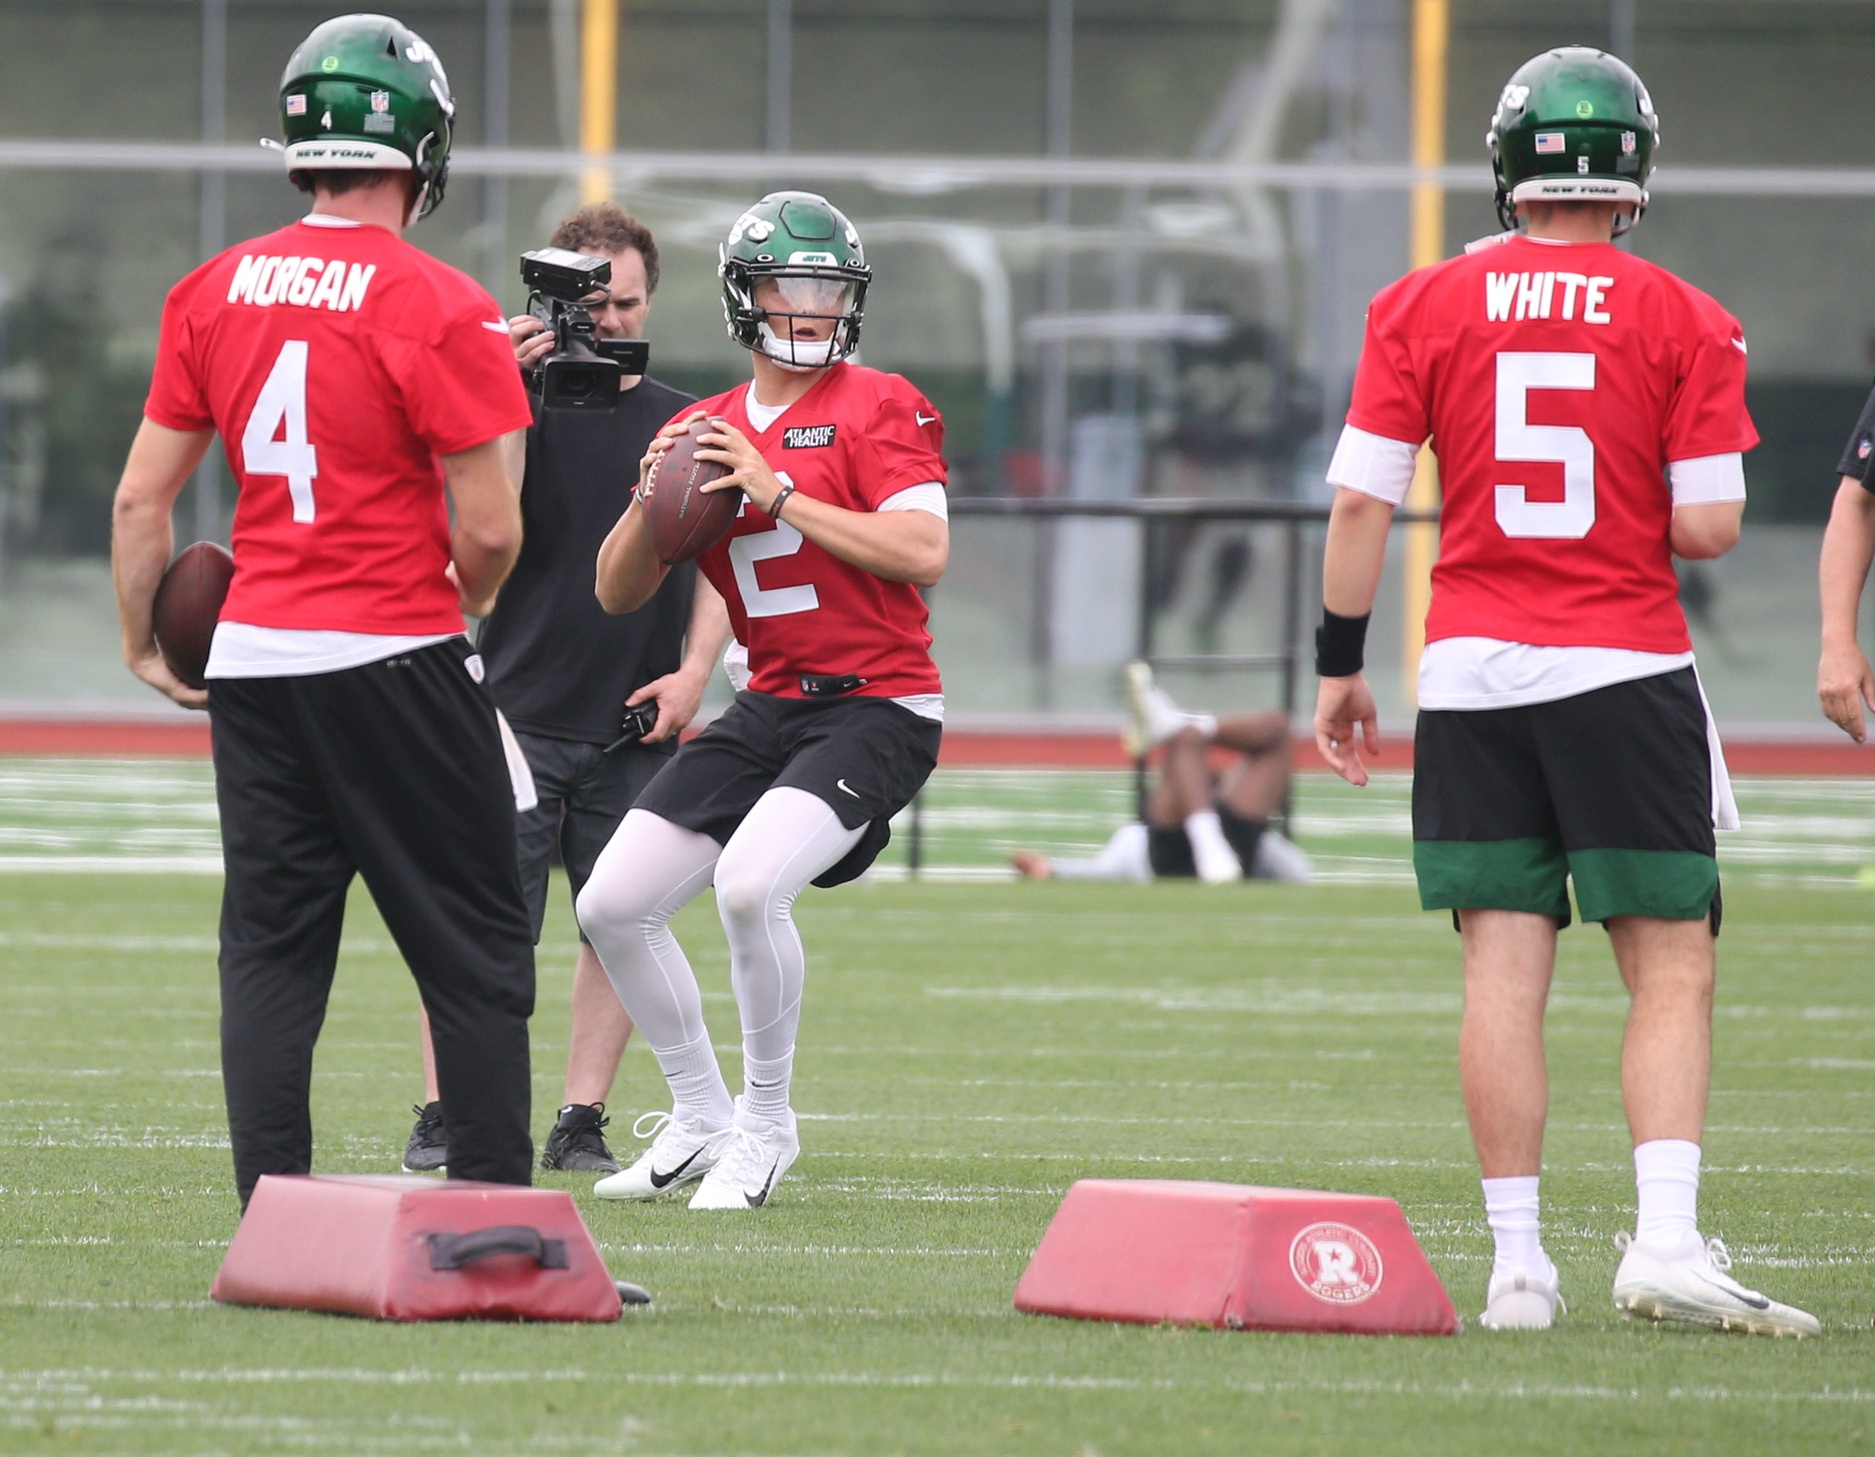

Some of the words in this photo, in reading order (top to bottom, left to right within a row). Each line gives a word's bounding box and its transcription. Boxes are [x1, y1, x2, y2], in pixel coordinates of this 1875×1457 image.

[321, 110, 332, 130] 4
[296, 148, 326, 159] NEW
[330, 149, 377, 159] YORK
[1577, 156, 1590, 175] 5
[1542, 186, 1574, 194] NEW
[1580, 186, 1620, 194] YORK
[227, 254, 376, 311] MORGAN
[1486, 271, 1614, 324] WHITE
[242, 339, 318, 524] 4
[784, 425, 835, 439] ATLANTIC
[790, 435, 829, 447] HEALTH
[1494, 352, 1596, 539] 5
[678, 486, 693, 519] NATIONAL
[729, 472, 819, 618] 2
[1313, 1239, 1359, 1285] R
[1310, 1279, 1371, 1300] ROGERS
